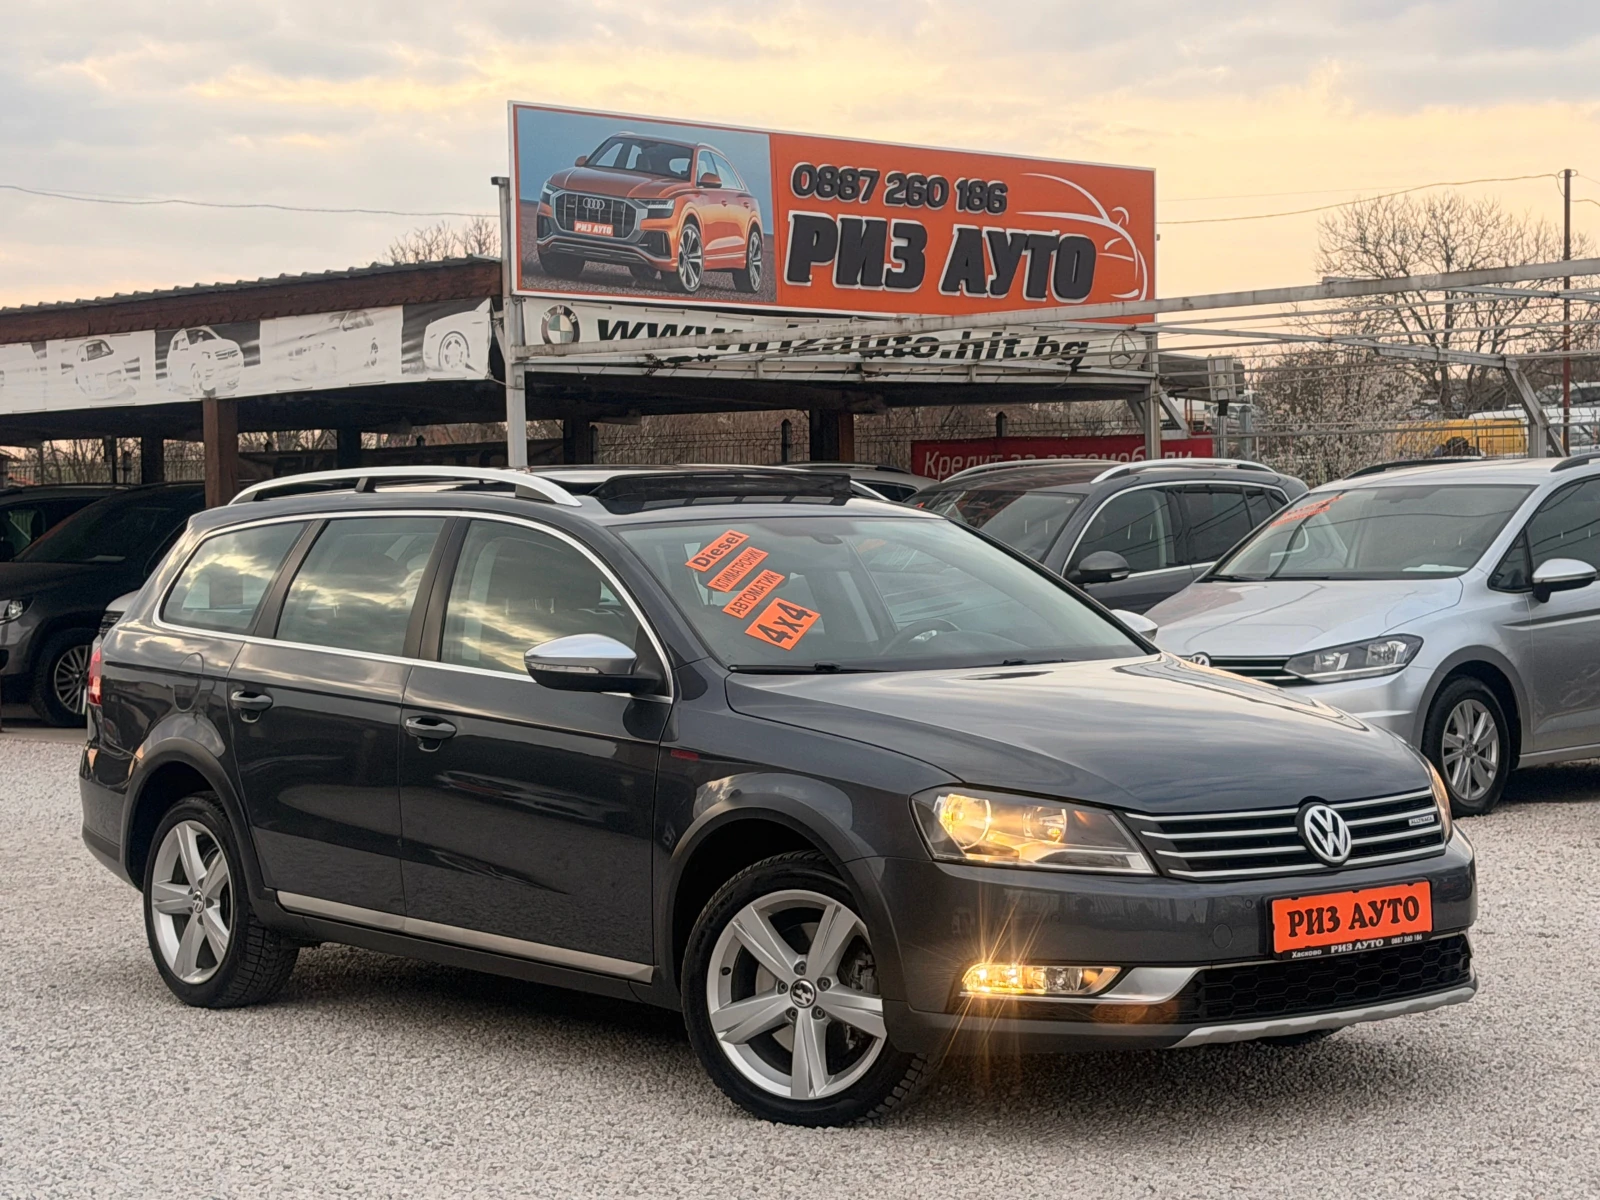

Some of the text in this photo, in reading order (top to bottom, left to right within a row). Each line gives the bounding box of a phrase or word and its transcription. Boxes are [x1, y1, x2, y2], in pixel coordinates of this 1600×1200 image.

[790, 162, 1009, 214] 0887 260 186
[592, 224, 612, 235] АУТО
[783, 210, 1097, 303] РИЗ АУТО
[692, 532, 744, 567] Diesel
[713, 548, 763, 590] КЛИМАТРОНИК
[730, 571, 780, 616] АВТОМАТИК
[1287, 895, 1420, 938] РИЗ АУТО
[1330, 943, 1351, 954] РИЗ
[1355, 938, 1384, 951] АУТО
